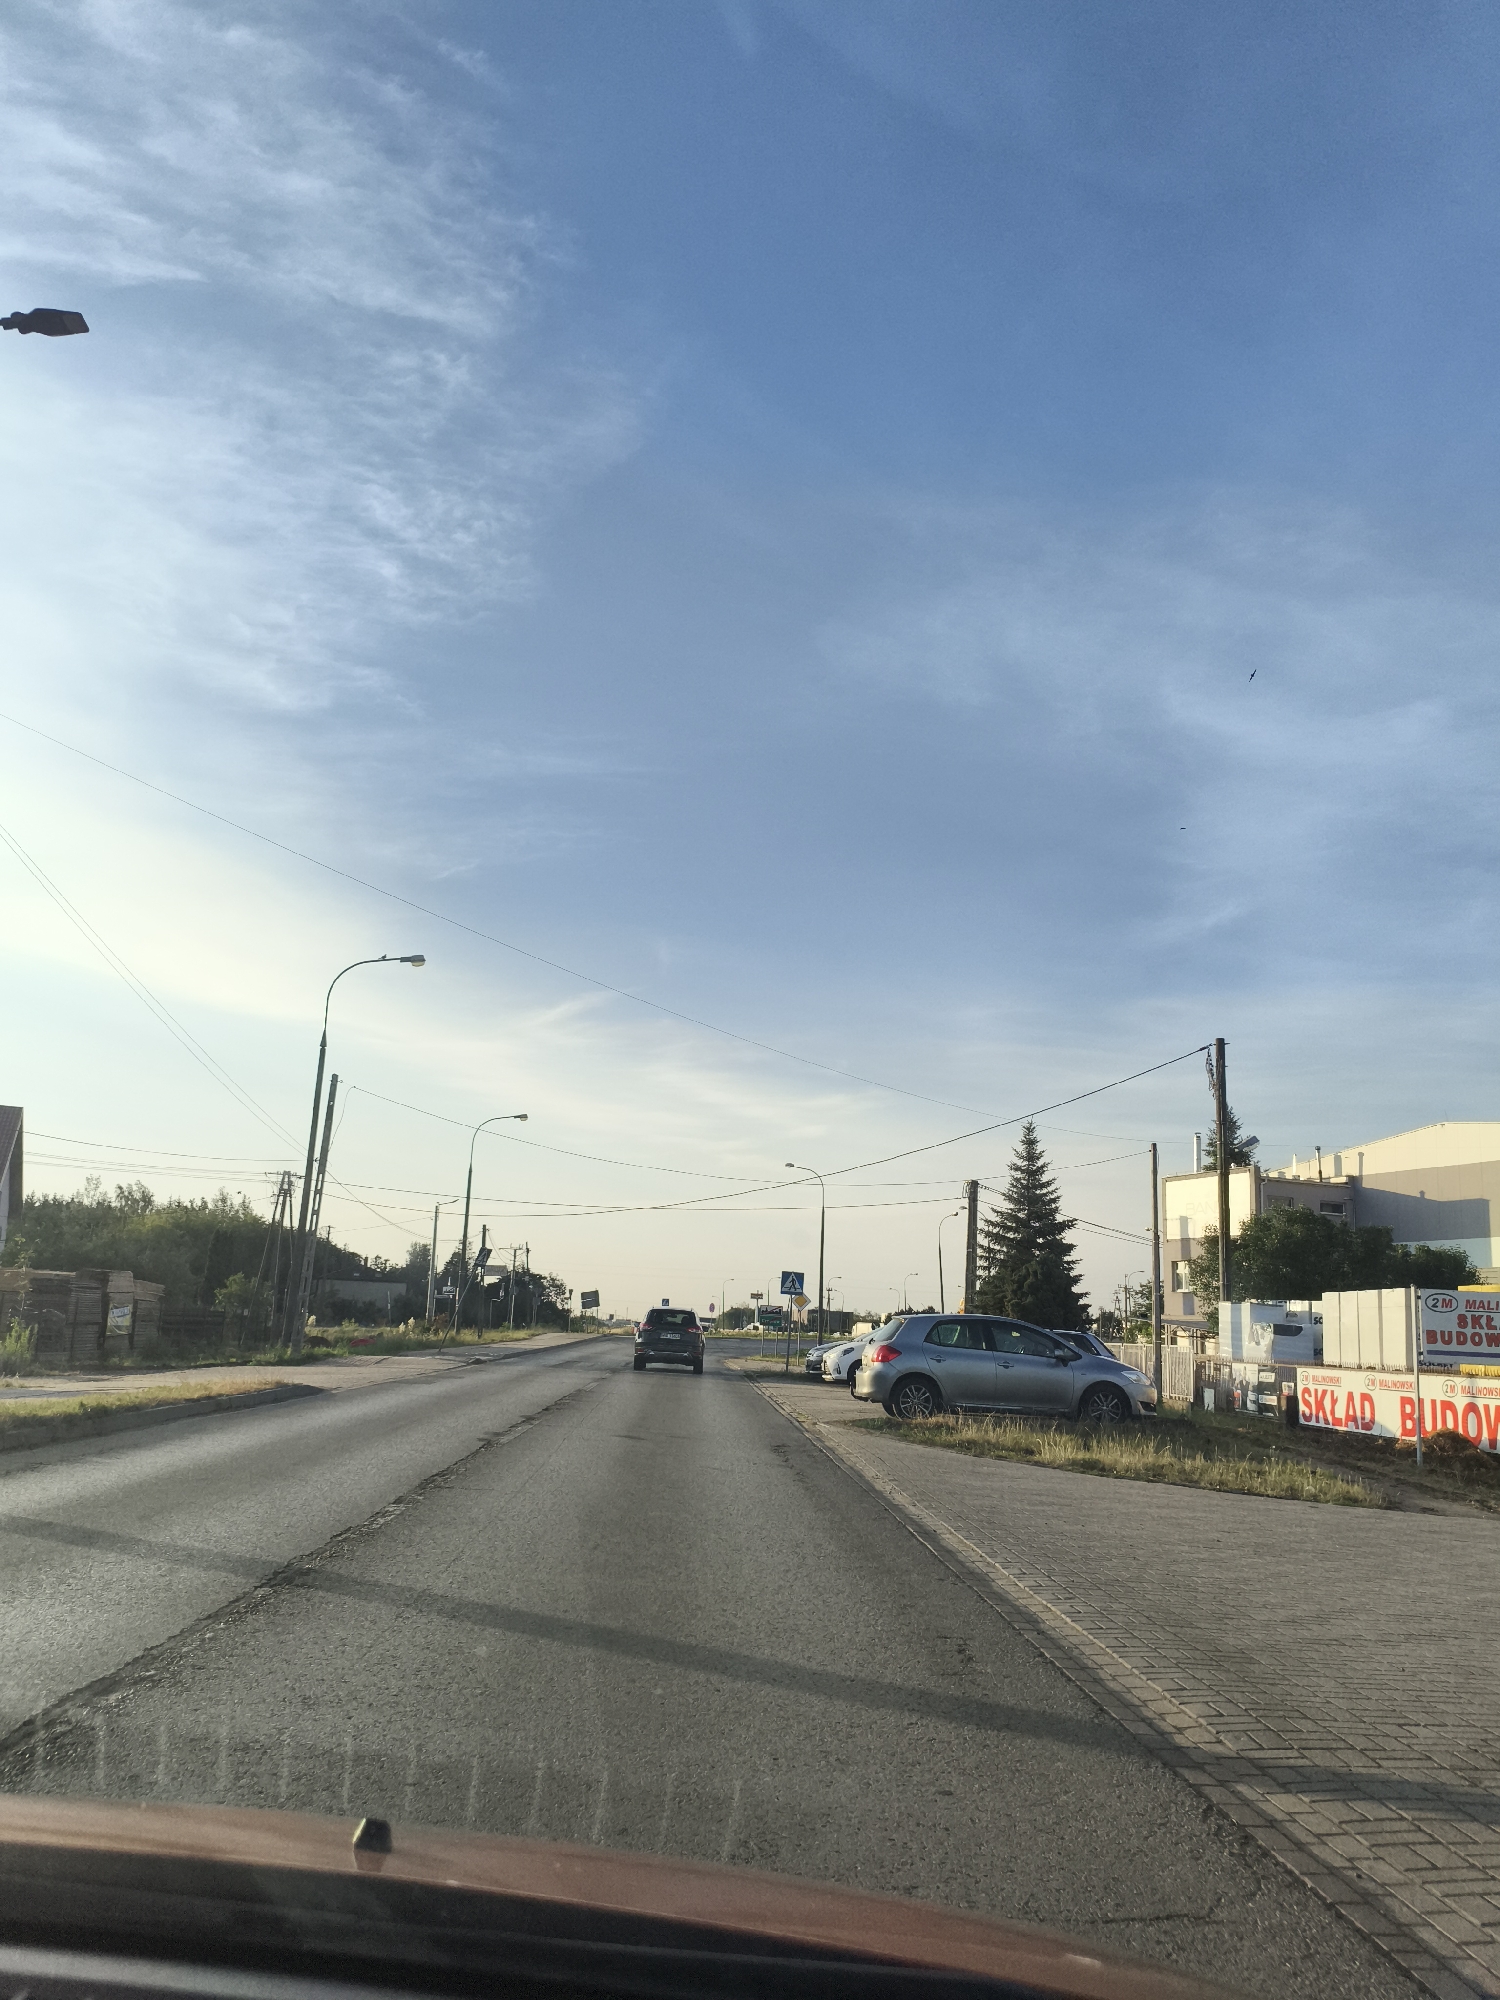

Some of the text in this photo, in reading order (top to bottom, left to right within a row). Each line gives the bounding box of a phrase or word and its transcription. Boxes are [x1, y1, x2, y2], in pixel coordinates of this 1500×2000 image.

[1431, 1297, 1453, 1309] 2M
[1457, 1313, 1500, 1330] SKŁ
[1312, 1374, 1342, 1385] MALINOWSKI
[1301, 1386, 1376, 1431] SKŁAD
